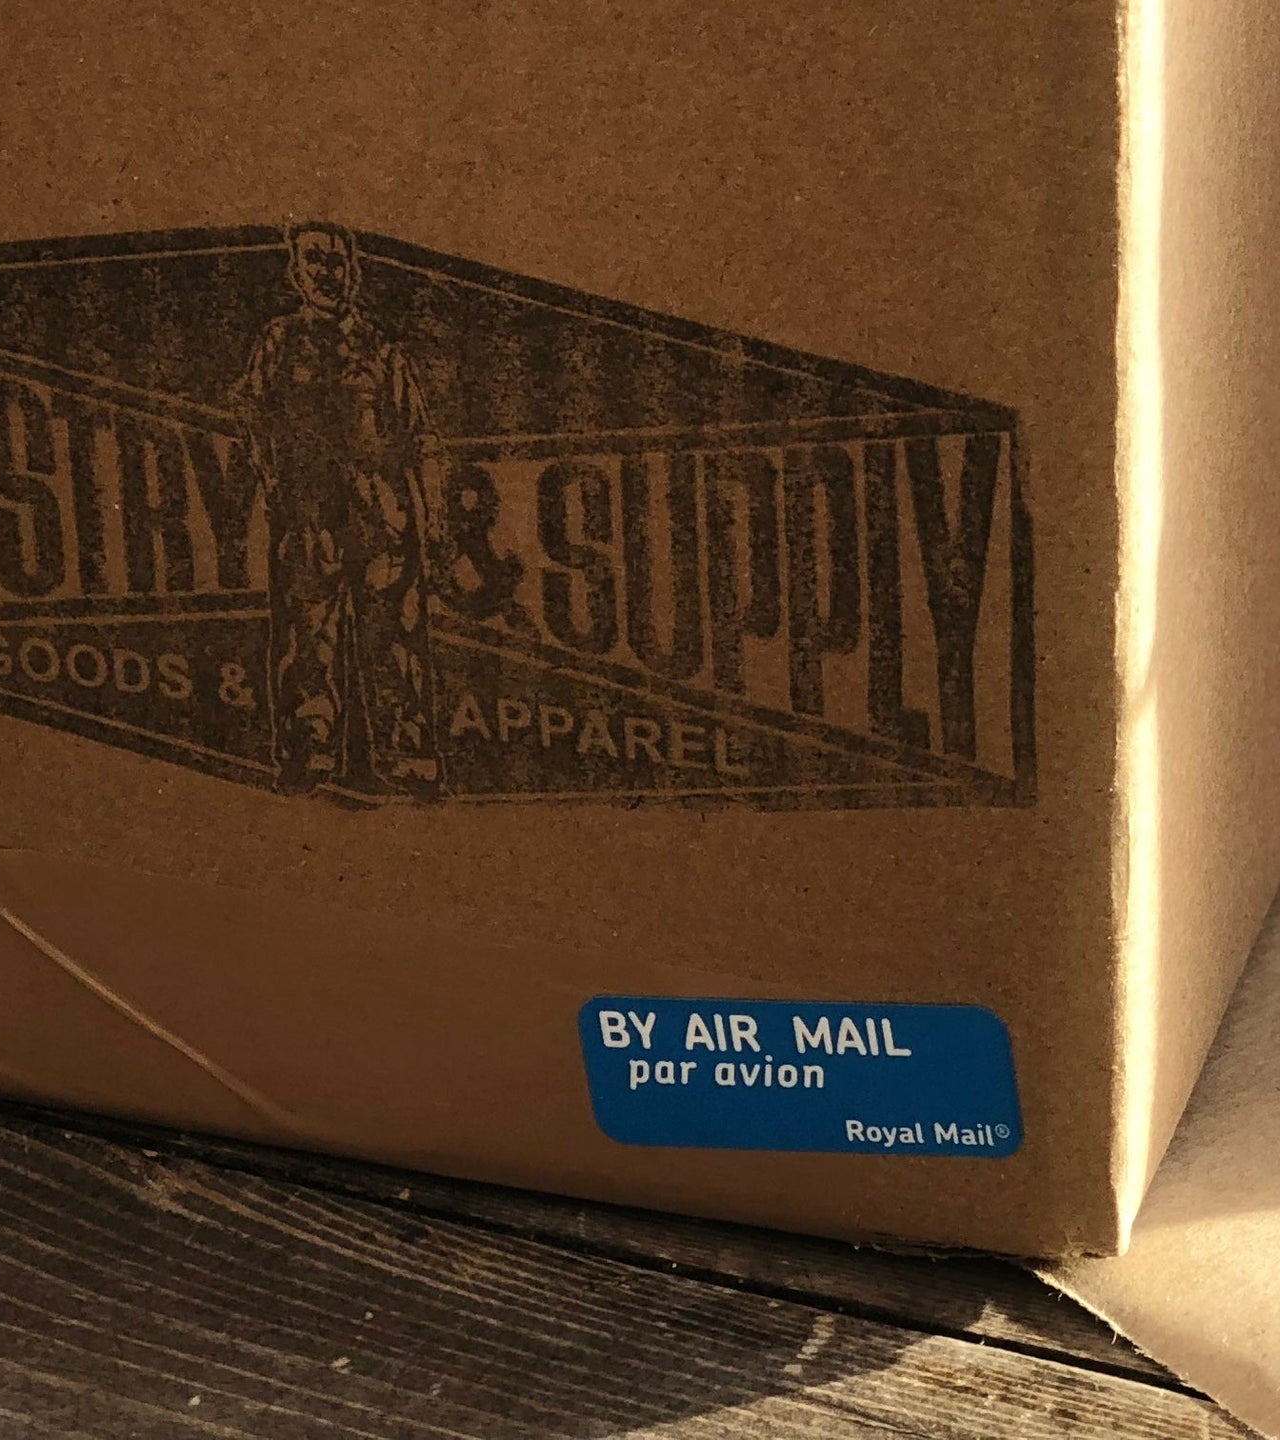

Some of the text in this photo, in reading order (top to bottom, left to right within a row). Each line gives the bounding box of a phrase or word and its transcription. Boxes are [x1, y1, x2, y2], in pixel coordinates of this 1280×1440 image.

[536, 432, 1002, 762] SUPPLY
[449, 693, 753, 776] APPAREL
[598, 1009, 913, 1057] BY AIR MAIL
[629, 1054, 826, 1091] par avion
[845, 1119, 924, 1148] Royal
